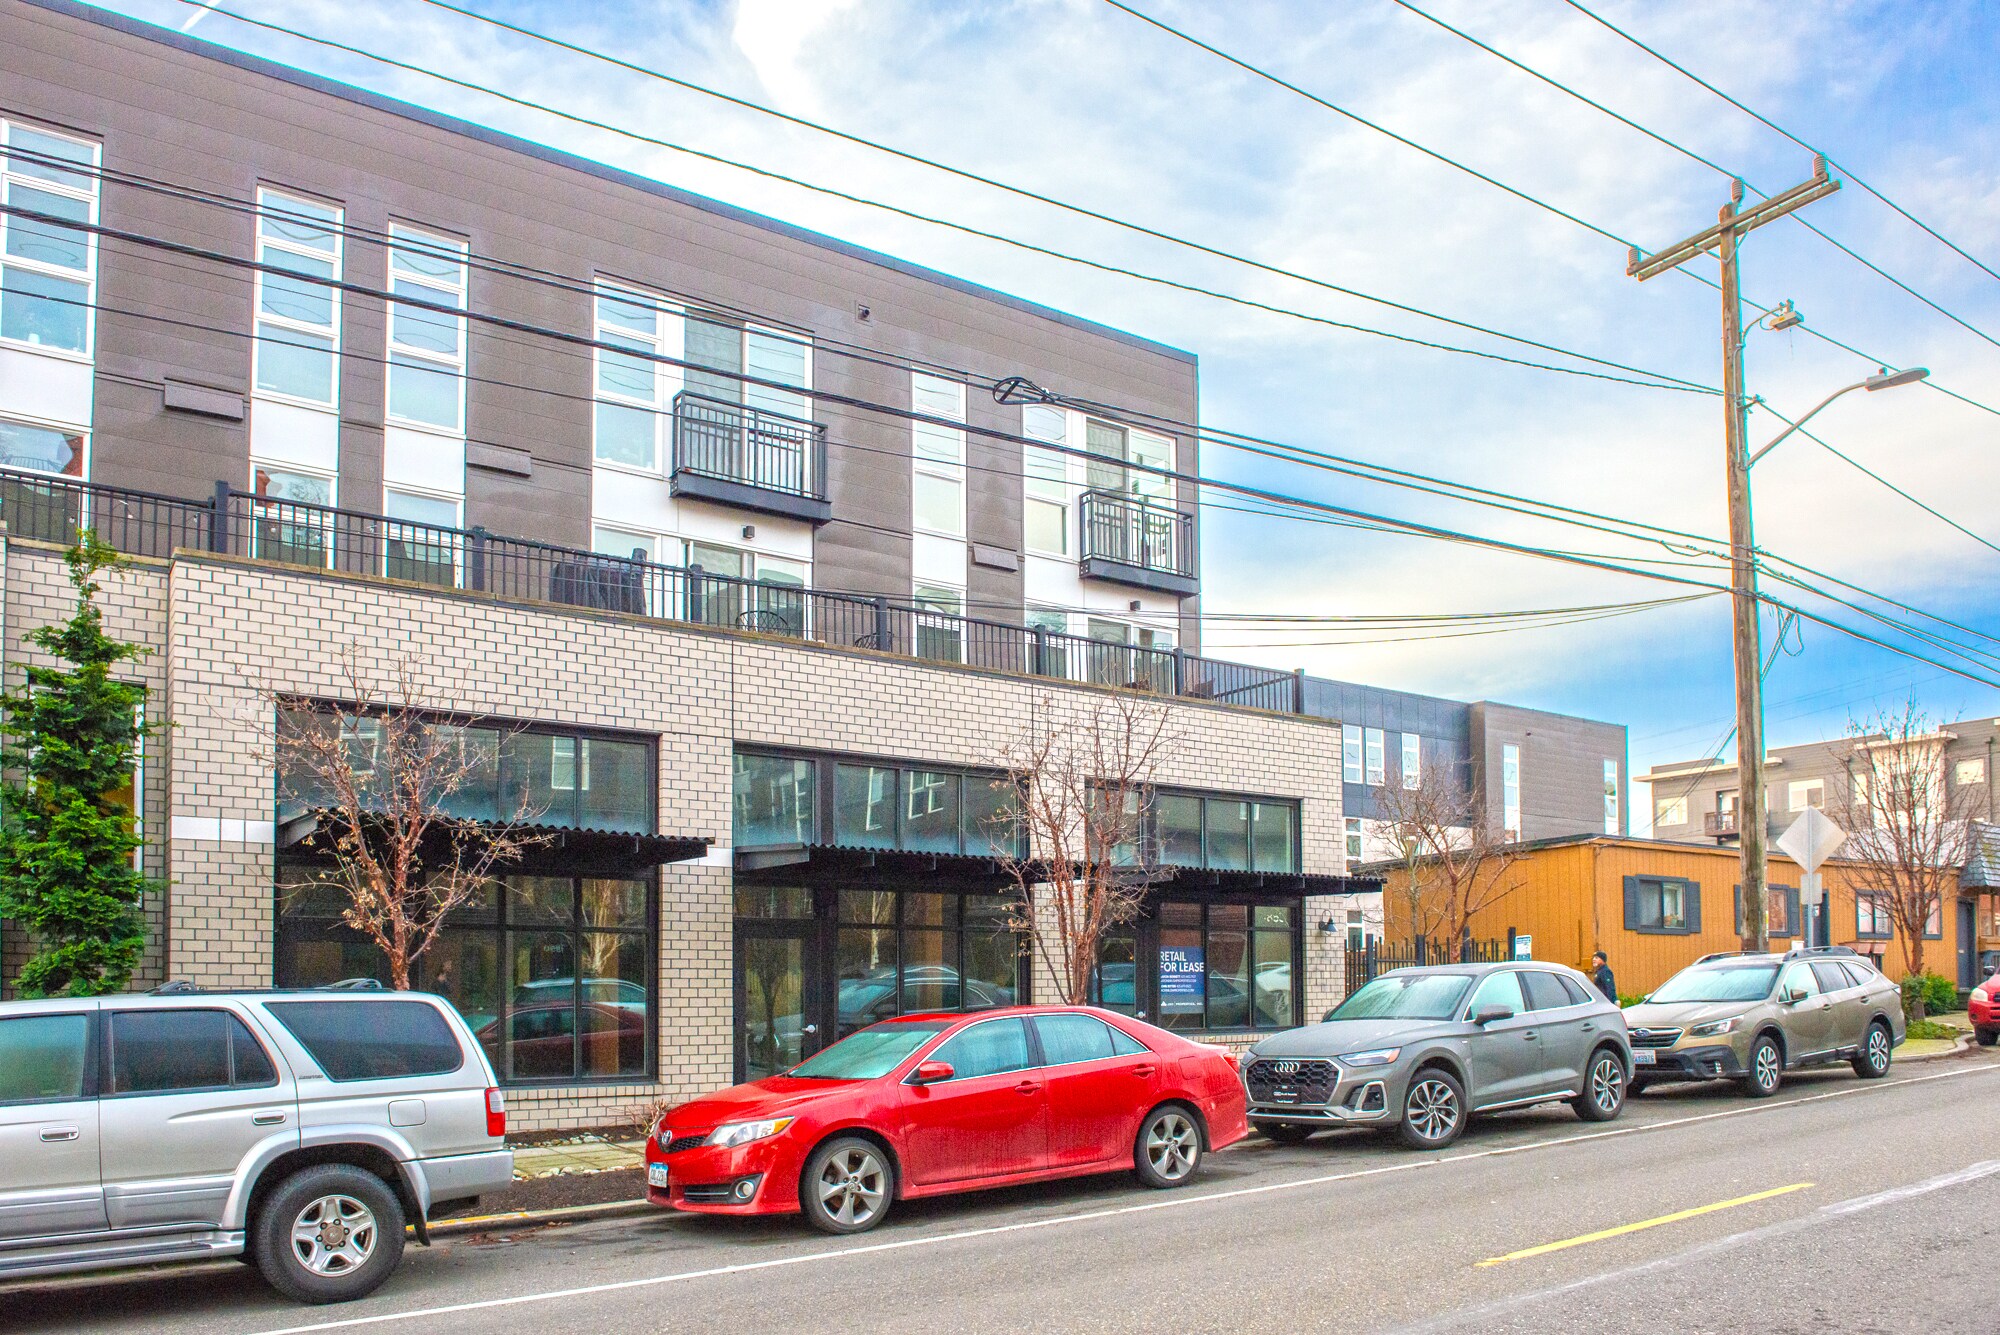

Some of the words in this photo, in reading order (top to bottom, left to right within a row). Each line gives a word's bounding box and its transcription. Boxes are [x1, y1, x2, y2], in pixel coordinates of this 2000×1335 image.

[1160, 951, 1186, 961] RETAIL
[1160, 962, 1177, 972] FOR
[1179, 962, 1204, 972] LEASE
